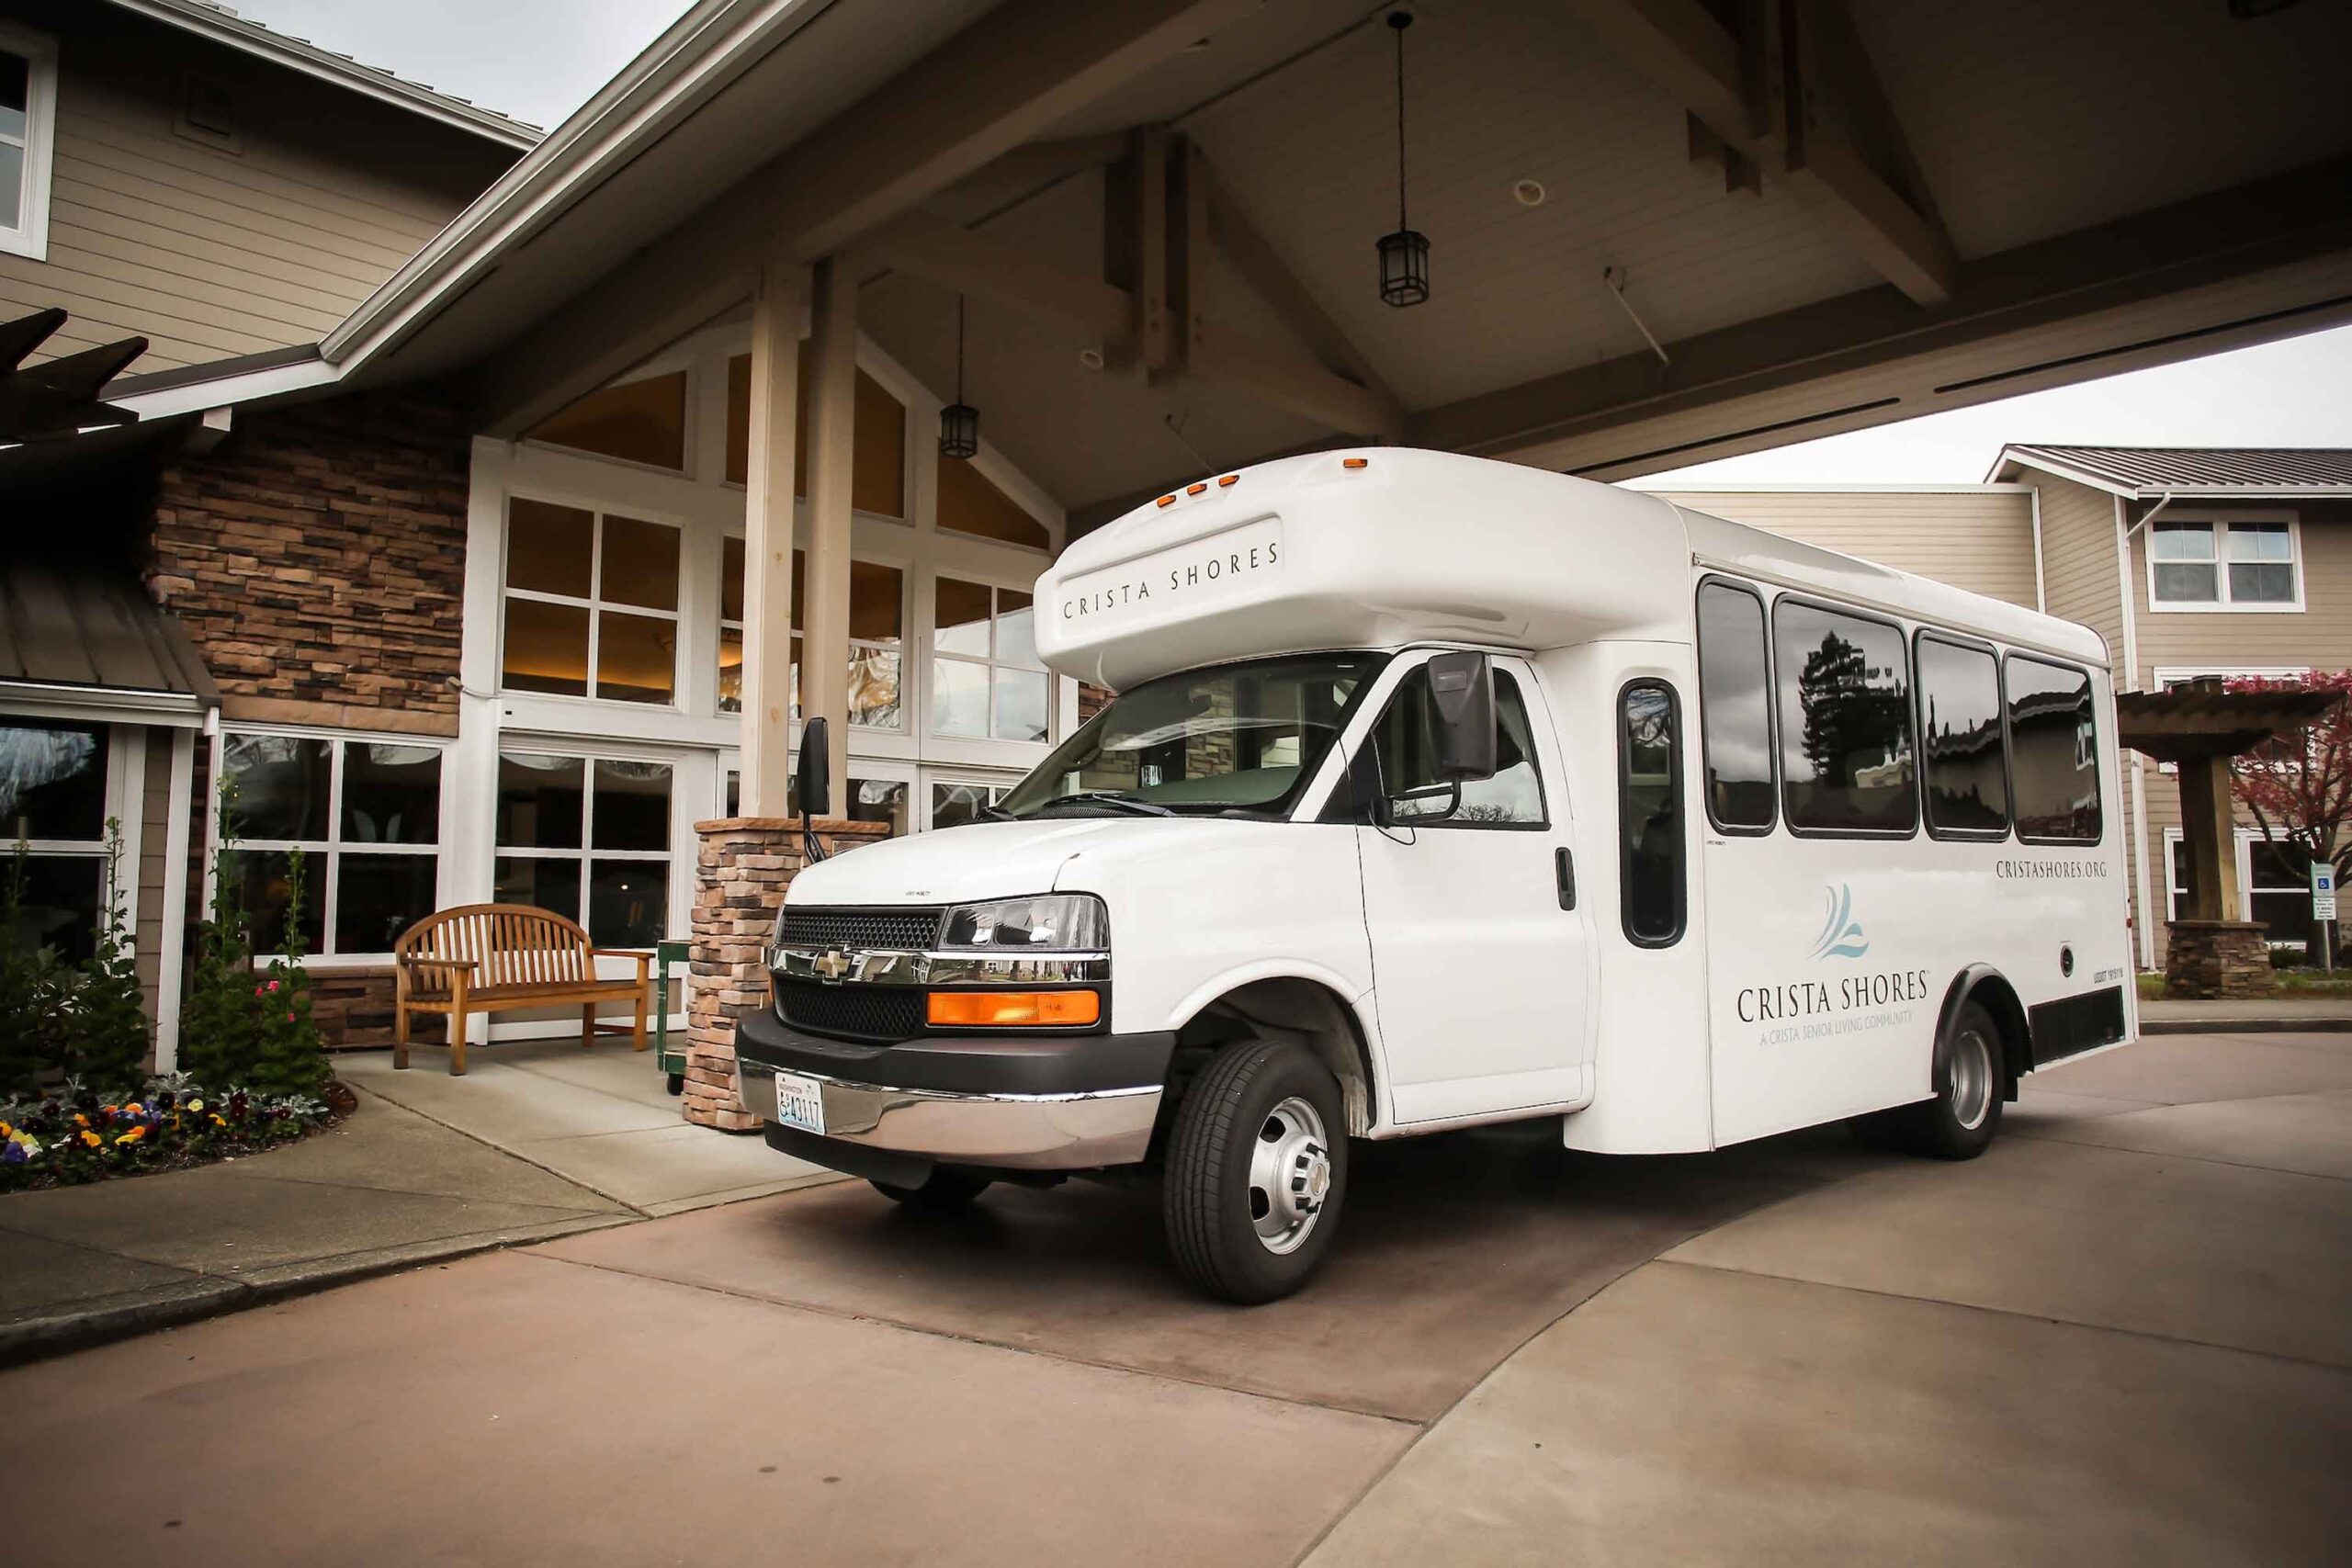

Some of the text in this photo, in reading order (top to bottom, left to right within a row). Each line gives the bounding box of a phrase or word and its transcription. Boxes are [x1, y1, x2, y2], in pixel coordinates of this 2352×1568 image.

[1063, 542, 1277, 619] CRISTA SHORES
[1996, 861, 2107, 878] CRISTASHORES.ORG
[1737, 969, 1927, 1022] CRISTA SHORES
[1759, 1010, 1913, 1046] A CRISTA SENIOR LIVING COMMUNITY
